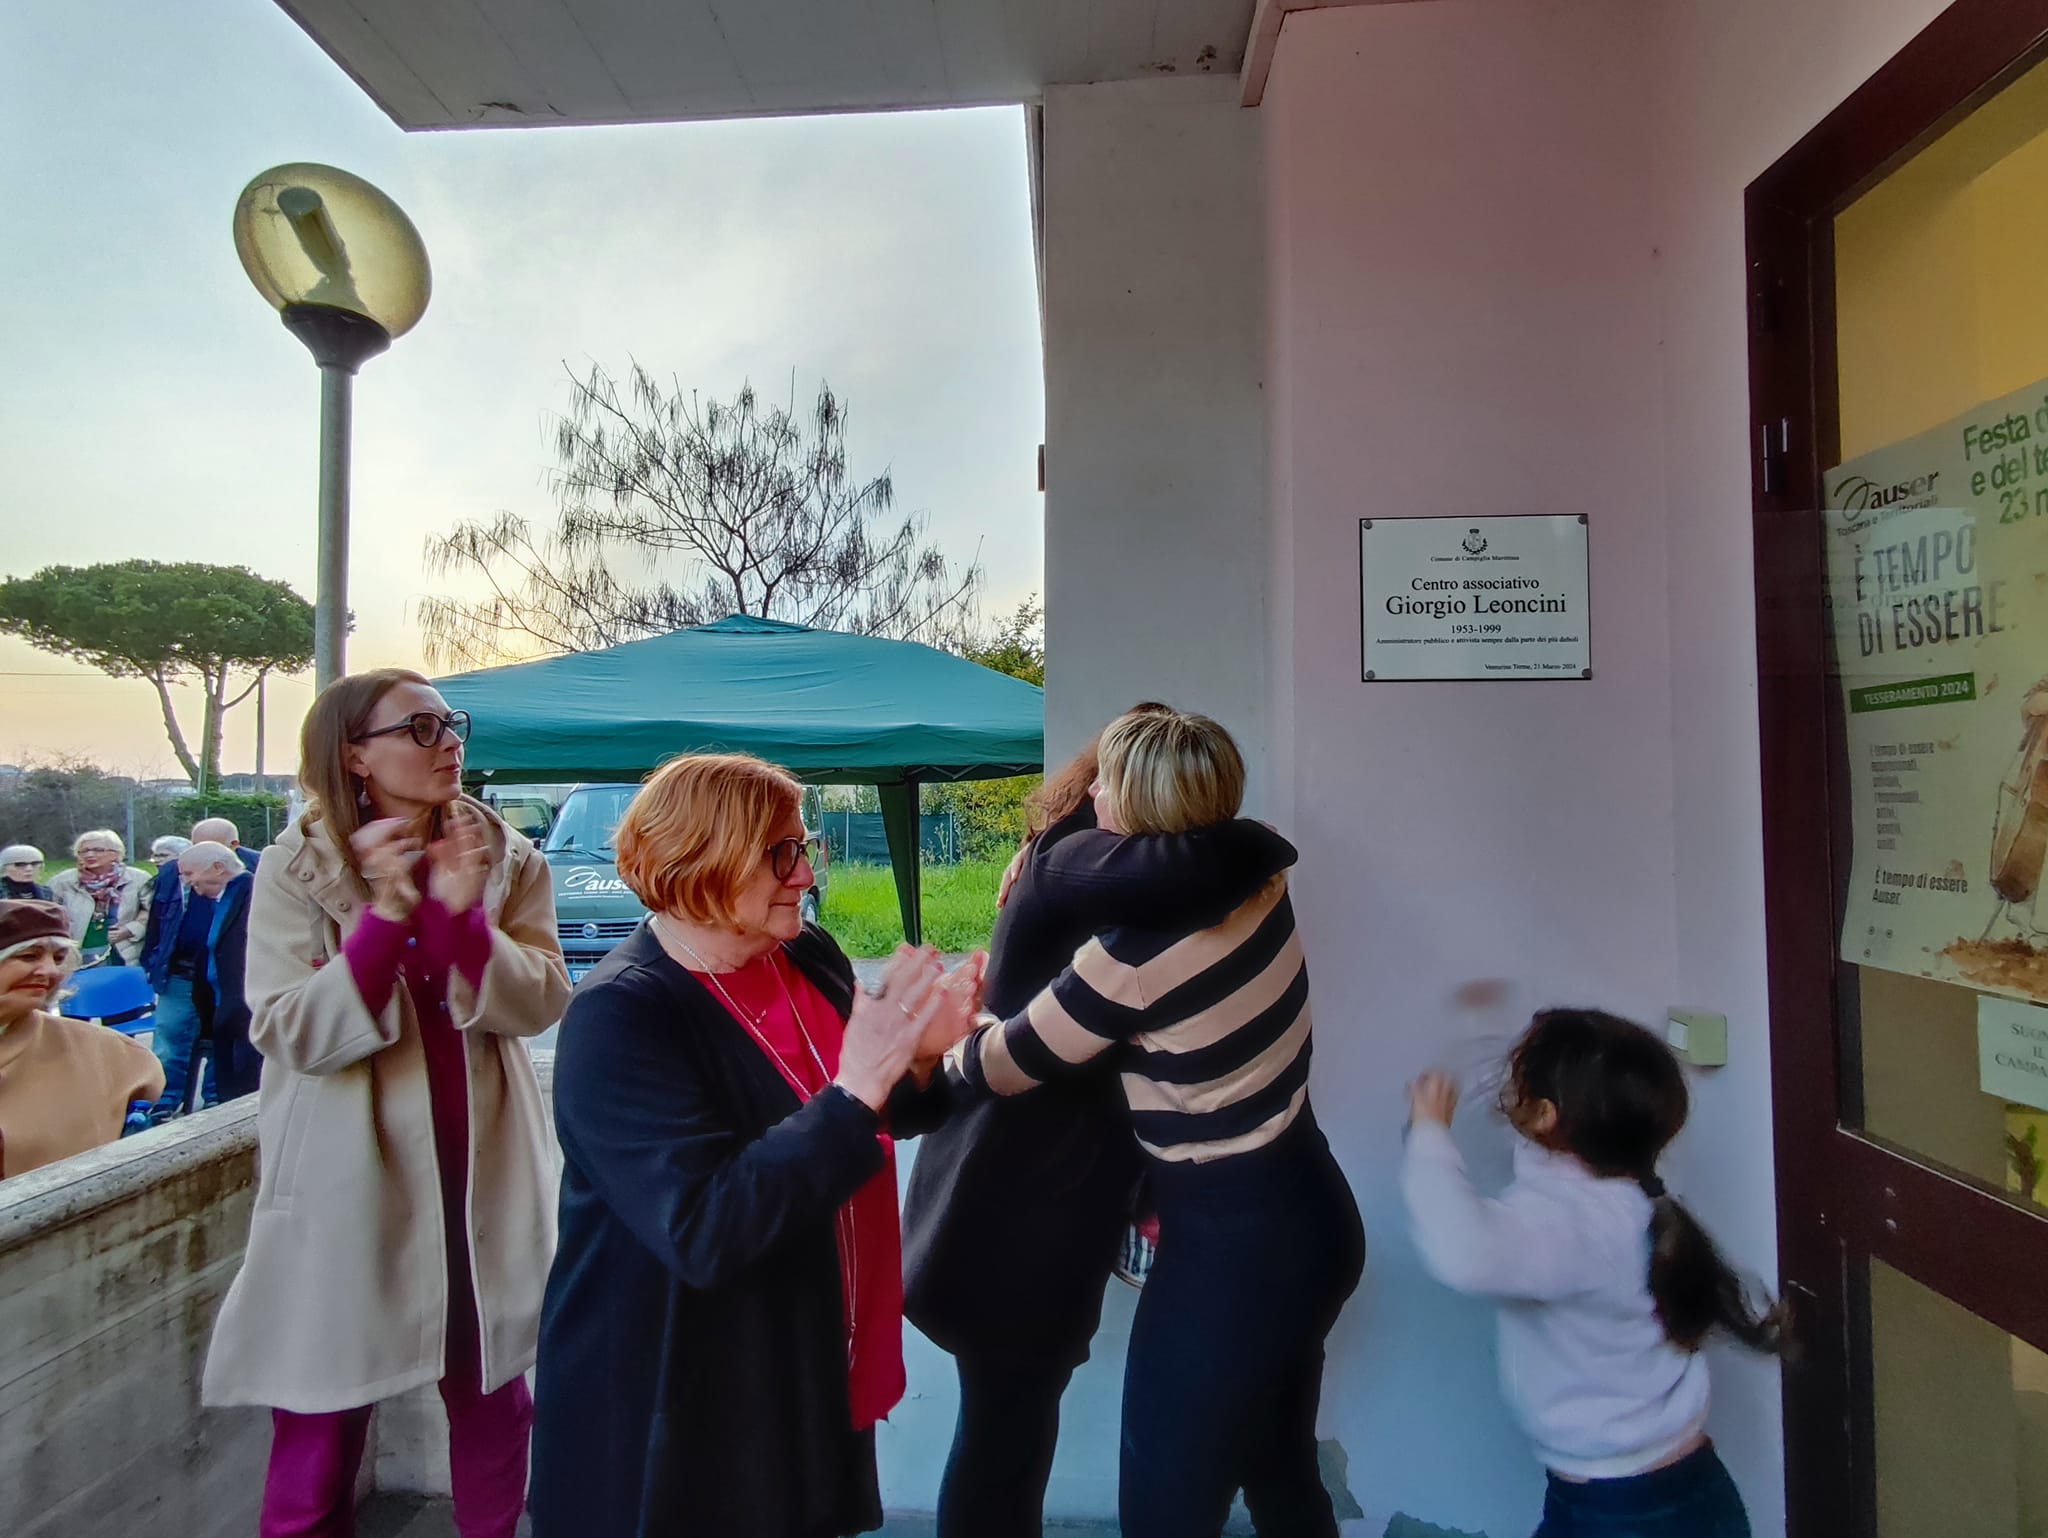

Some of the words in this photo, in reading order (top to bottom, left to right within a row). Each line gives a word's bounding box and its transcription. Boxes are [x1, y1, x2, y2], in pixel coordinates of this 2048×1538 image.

[1963, 413, 2031, 461] Festa
[1971, 471, 1986, 496] e
[1991, 446, 2027, 490] del
[1870, 471, 1939, 510] auser
[1999, 487, 2029, 524] 23
[1836, 519, 1871, 537] Toscana
[1873, 523, 1977, 594] TEMPO
[1411, 577, 1459, 591] Centro
[1462, 575, 1540, 590] associativo
[1385, 594, 1466, 620] Giorgio
[1473, 593, 1567, 614] Leoncini
[1423, 637, 1450, 646] pubblico
[1451, 624, 1502, 634] 1953-1999
[1858, 608, 1884, 657] DI
[1864, 684, 1938, 705] TESSERAMENTO
[1940, 680, 1970, 697] 2024
[1882, 870, 1915, 889] tempo
[1916, 873, 1928, 889] di
[1929, 876, 1968, 894] essere
